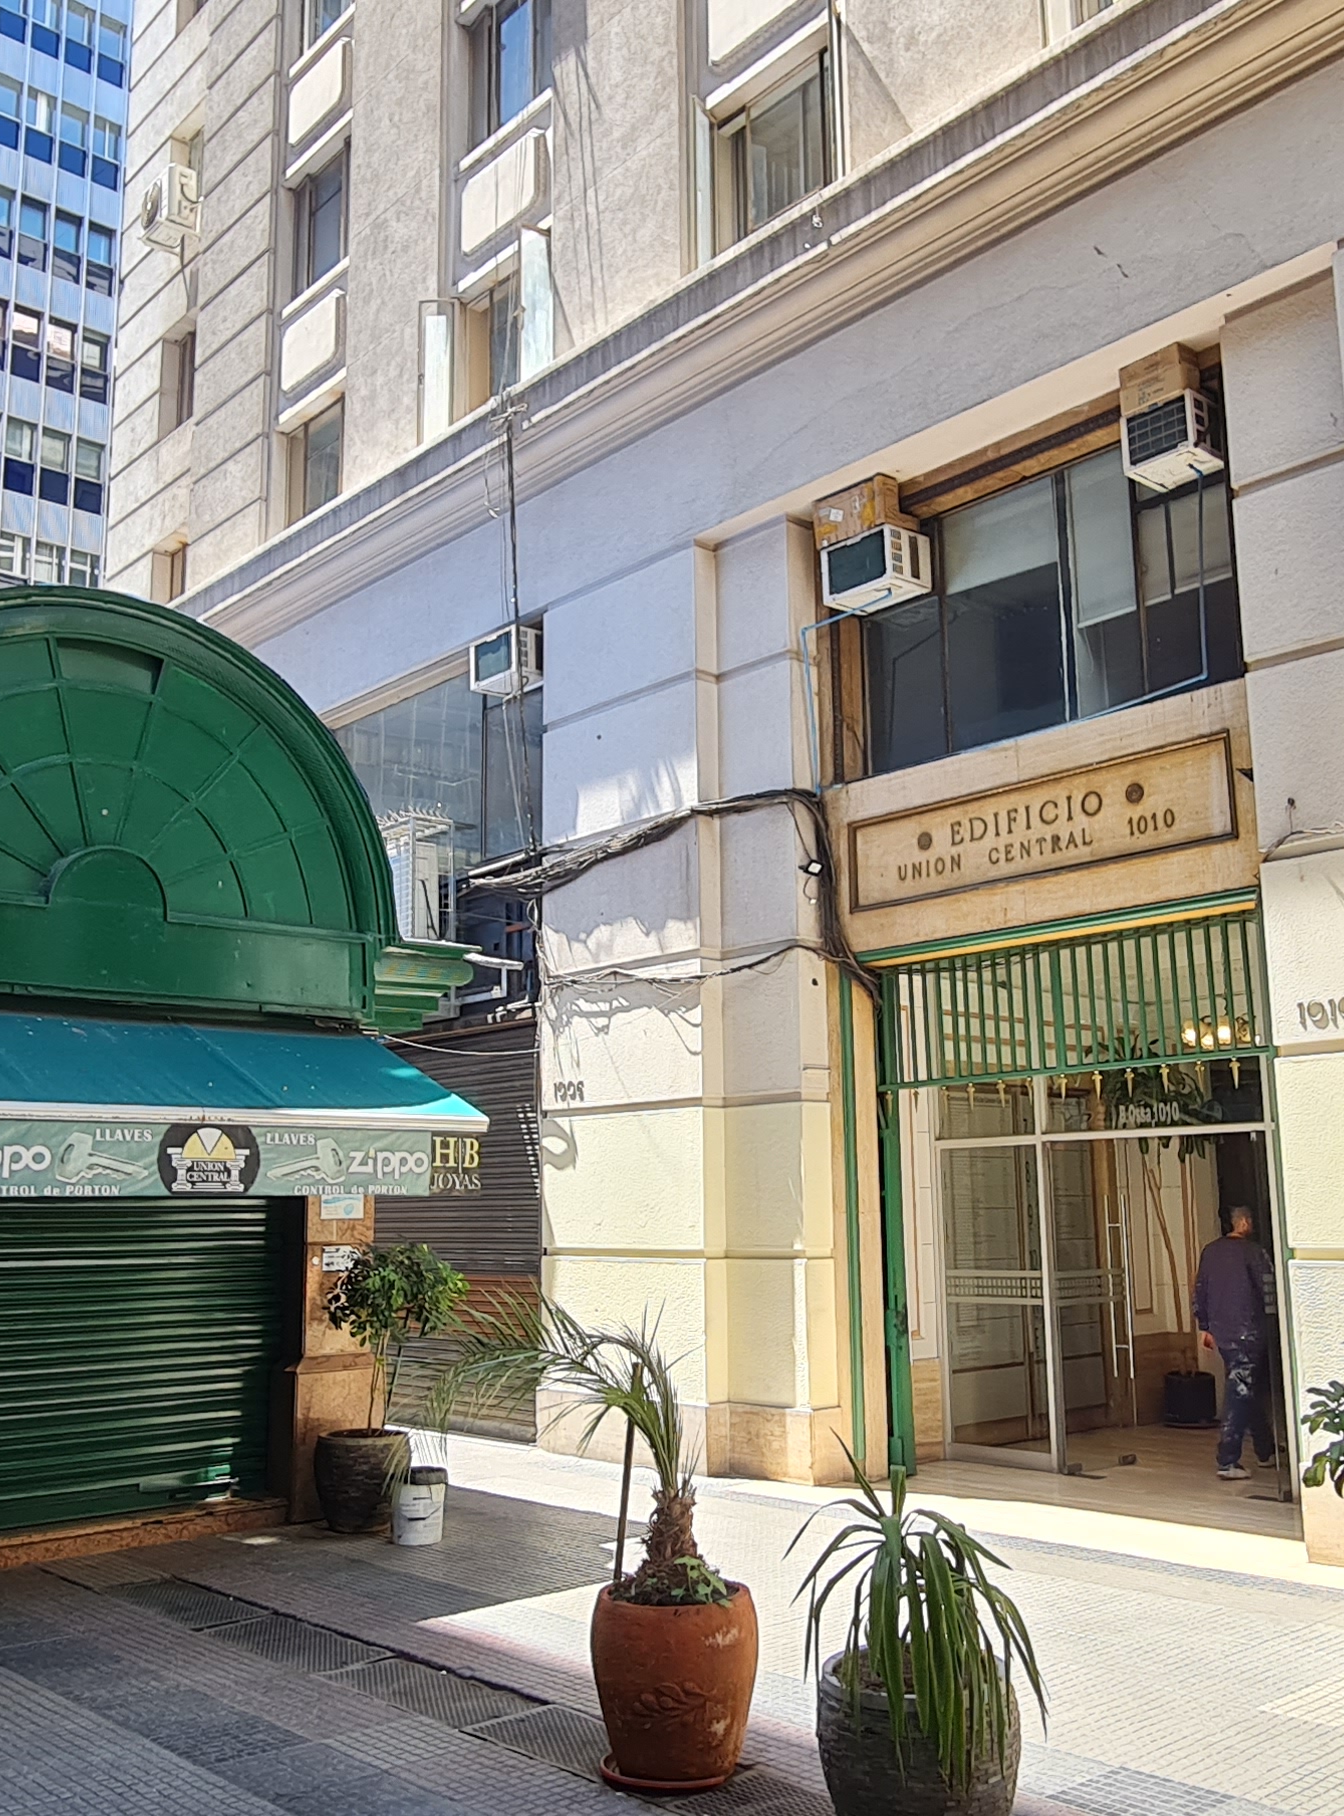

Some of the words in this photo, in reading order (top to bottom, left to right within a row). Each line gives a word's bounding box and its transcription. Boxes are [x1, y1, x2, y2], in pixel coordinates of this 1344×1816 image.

[949, 790, 1103, 848] EDIFICIO
[897, 855, 963, 882] UNION
[987, 828, 1094, 865] CENTRAL
[1126, 808, 1176, 837] 1010
[94, 1128, 153, 1142] LLAVES
[265, 1132, 316, 1146] LLAVES
[193, 1162, 224, 1171] UNION
[348, 1147, 429, 1179] zippo
[186, 1172, 229, 1181] CENTRAL
[430, 1173, 481, 1190] JOYAS
[43, 1185, 60, 1196] de
[65, 1185, 120, 1196] PORTON
[294, 1185, 344, 1195] CONTROL
[351, 1184, 365, 1195] de
[368, 1185, 406, 1194] PORTON
